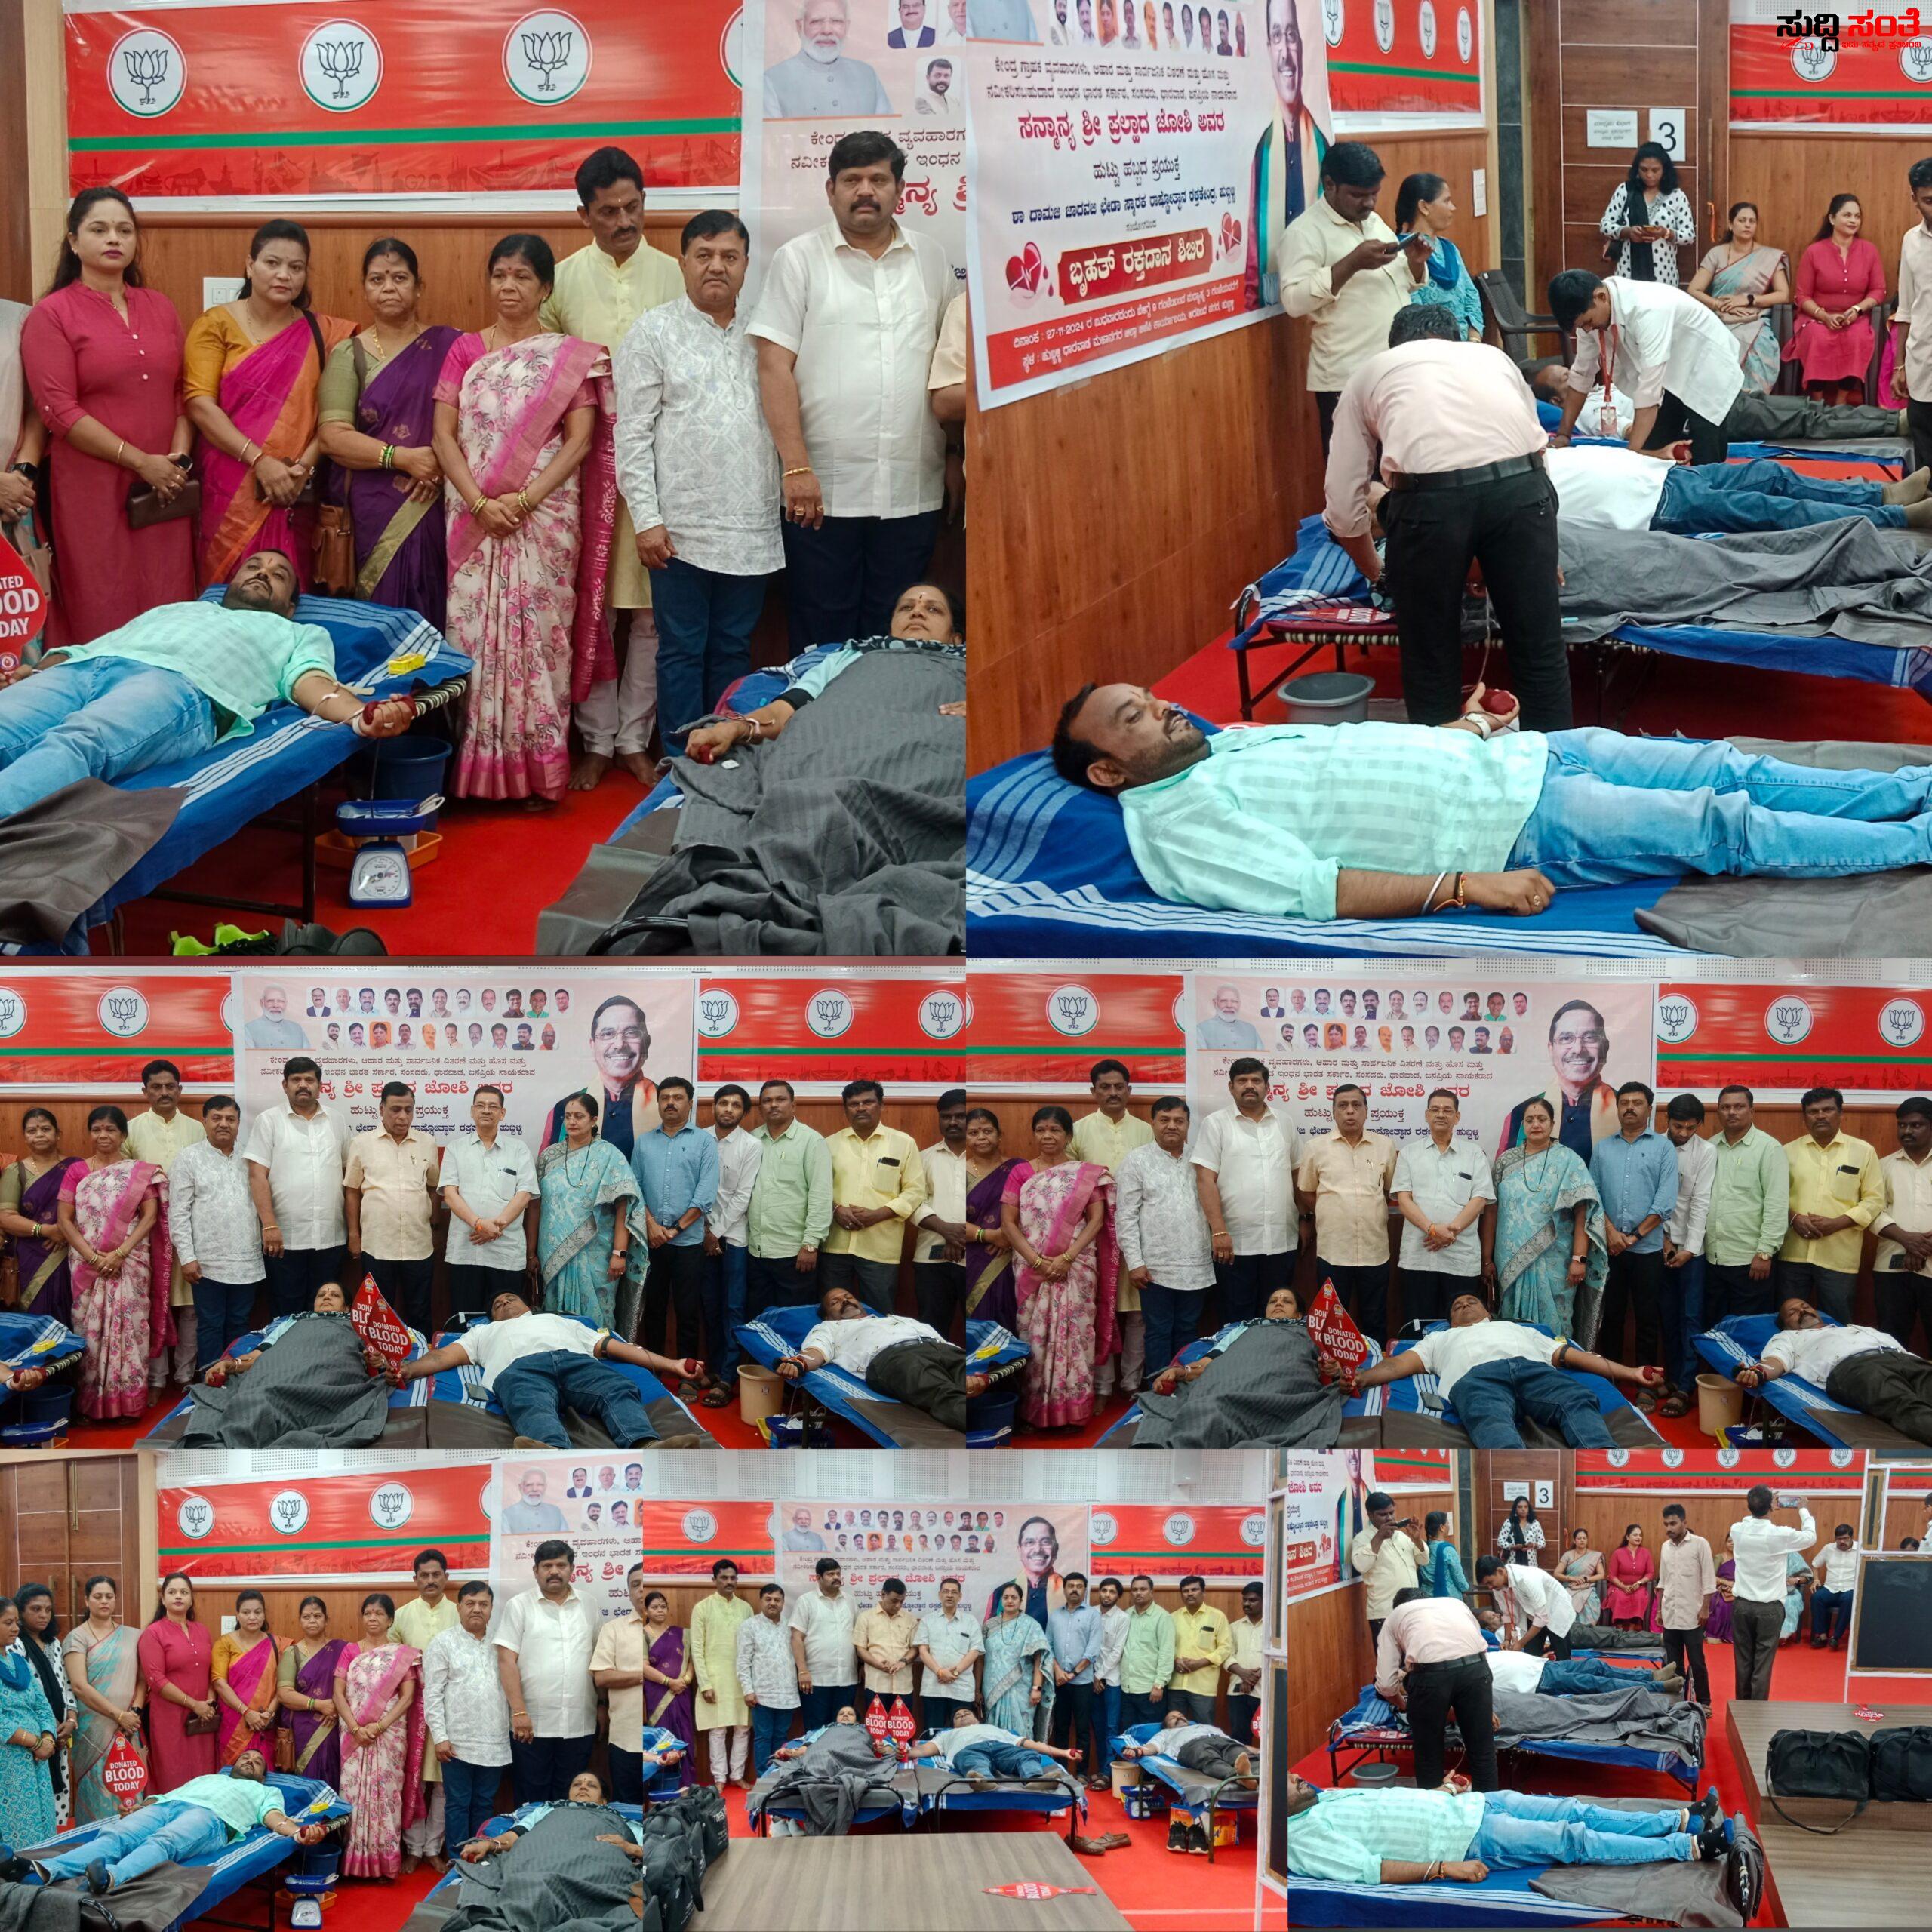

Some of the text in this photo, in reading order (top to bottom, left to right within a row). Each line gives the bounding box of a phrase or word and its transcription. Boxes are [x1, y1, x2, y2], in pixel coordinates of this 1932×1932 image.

[1018, 108, 1225, 151] ಸನ್ಮಾನ್ಯ ಶ್ರೀ ಪ್ರಲ್ಹಾದ ಜೋಶಿ ಅವರ
[1659, 122, 1677, 152] 3
[916, 152, 961, 168] ಇಂಧನ
[1093, 154, 1180, 188] ಹುಟ್ಟು ಹಬ್ಬದ ಪ್ರಯುಕ್ತ
[1069, 232, 1205, 297] ಬೃಹತ್ ರಕ್ತದಾನ ಶಿಬಿರ
[1013, 331, 1040, 349] ದಿನಾಂಕ
[1046, 321, 1084, 340] 27-11-2024
[1086, 316, 1093, 328] ರ
[386, 1057, 403, 1067] ಮತ್ತು
[406, 1057, 441, 1065] ಸಾರ್ವಜನಿಕ
[469, 1057, 486, 1067] ಮತ್ತು
[510, 1057, 527, 1068] ಮತ್ತು
[1341, 1059, 1358, 1069] ಮತ್ತು
[1361, 1060, 1396, 1068] ಸಾರ್ವಜನಿಕ
[1426, 1060, 1443, 1070] ಮತ್ತು
[1466, 1061, 1484, 1071] ಮತ್ತು
[343, 1079, 363, 1098] ಶ್ರೀ
[425, 1079, 469, 1094] ಜೋಶಿ
[1297, 1081, 1318, 1100] ಶ್ರೀ
[1380, 1082, 1426, 1097] ಜೋಶಿ
[1371, 1107, 1404, 1123] ಪ್ರಯುಕ್ತ
[373, 1321, 401, 1333] DONATED
[1328, 1327, 1356, 1339] DONATED
[368, 1327, 408, 1346] BLOOD
[1323, 1333, 1364, 1352] BLOOD
[377, 1341, 404, 1355] TODAY
[1332, 1348, 1359, 1362] TODAY
[1540, 1487, 1549, 1504] 3
[609, 1549, 631, 1557] ಭಾರತ
[601, 1561, 624, 1580] ಶ್ರೀ
[888, 1721, 914, 1730] BLOOD
[109, 1760, 137, 1770] DONATED
[105, 1767, 145, 1783] BLOOD
[113, 1781, 140, 1792] TODAY
[1023, 1883, 1041, 1899] BLOOD
